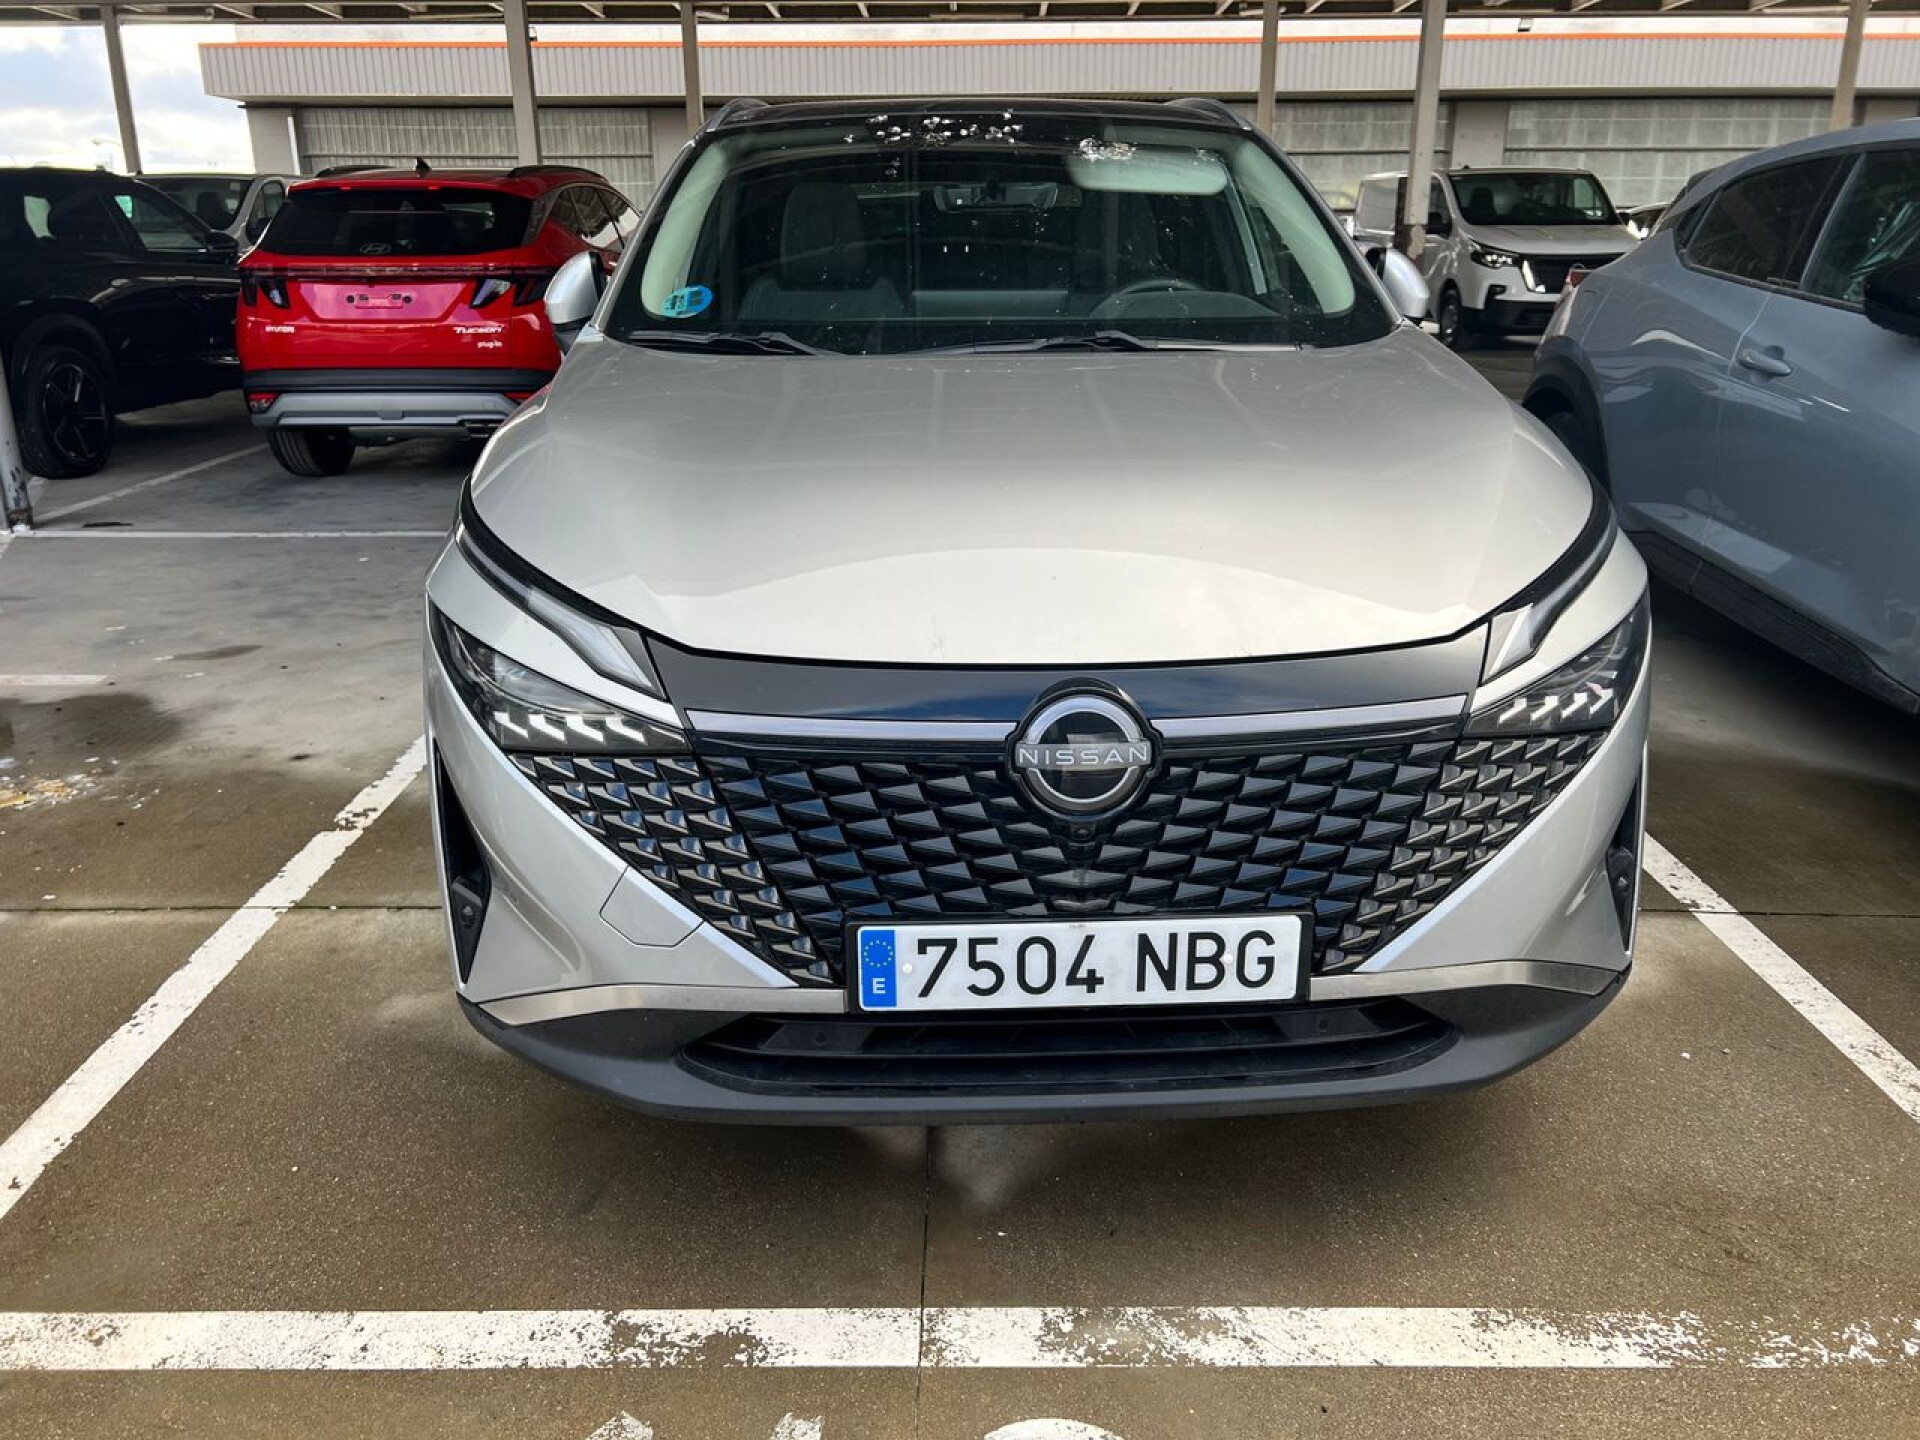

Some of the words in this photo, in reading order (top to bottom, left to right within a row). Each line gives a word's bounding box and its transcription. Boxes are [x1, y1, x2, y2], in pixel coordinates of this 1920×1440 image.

[1019, 746, 1147, 765] NISSAN
[917, 934, 1104, 998] 7504
[1136, 930, 1276, 992] NBG
[872, 977, 886, 994] E
